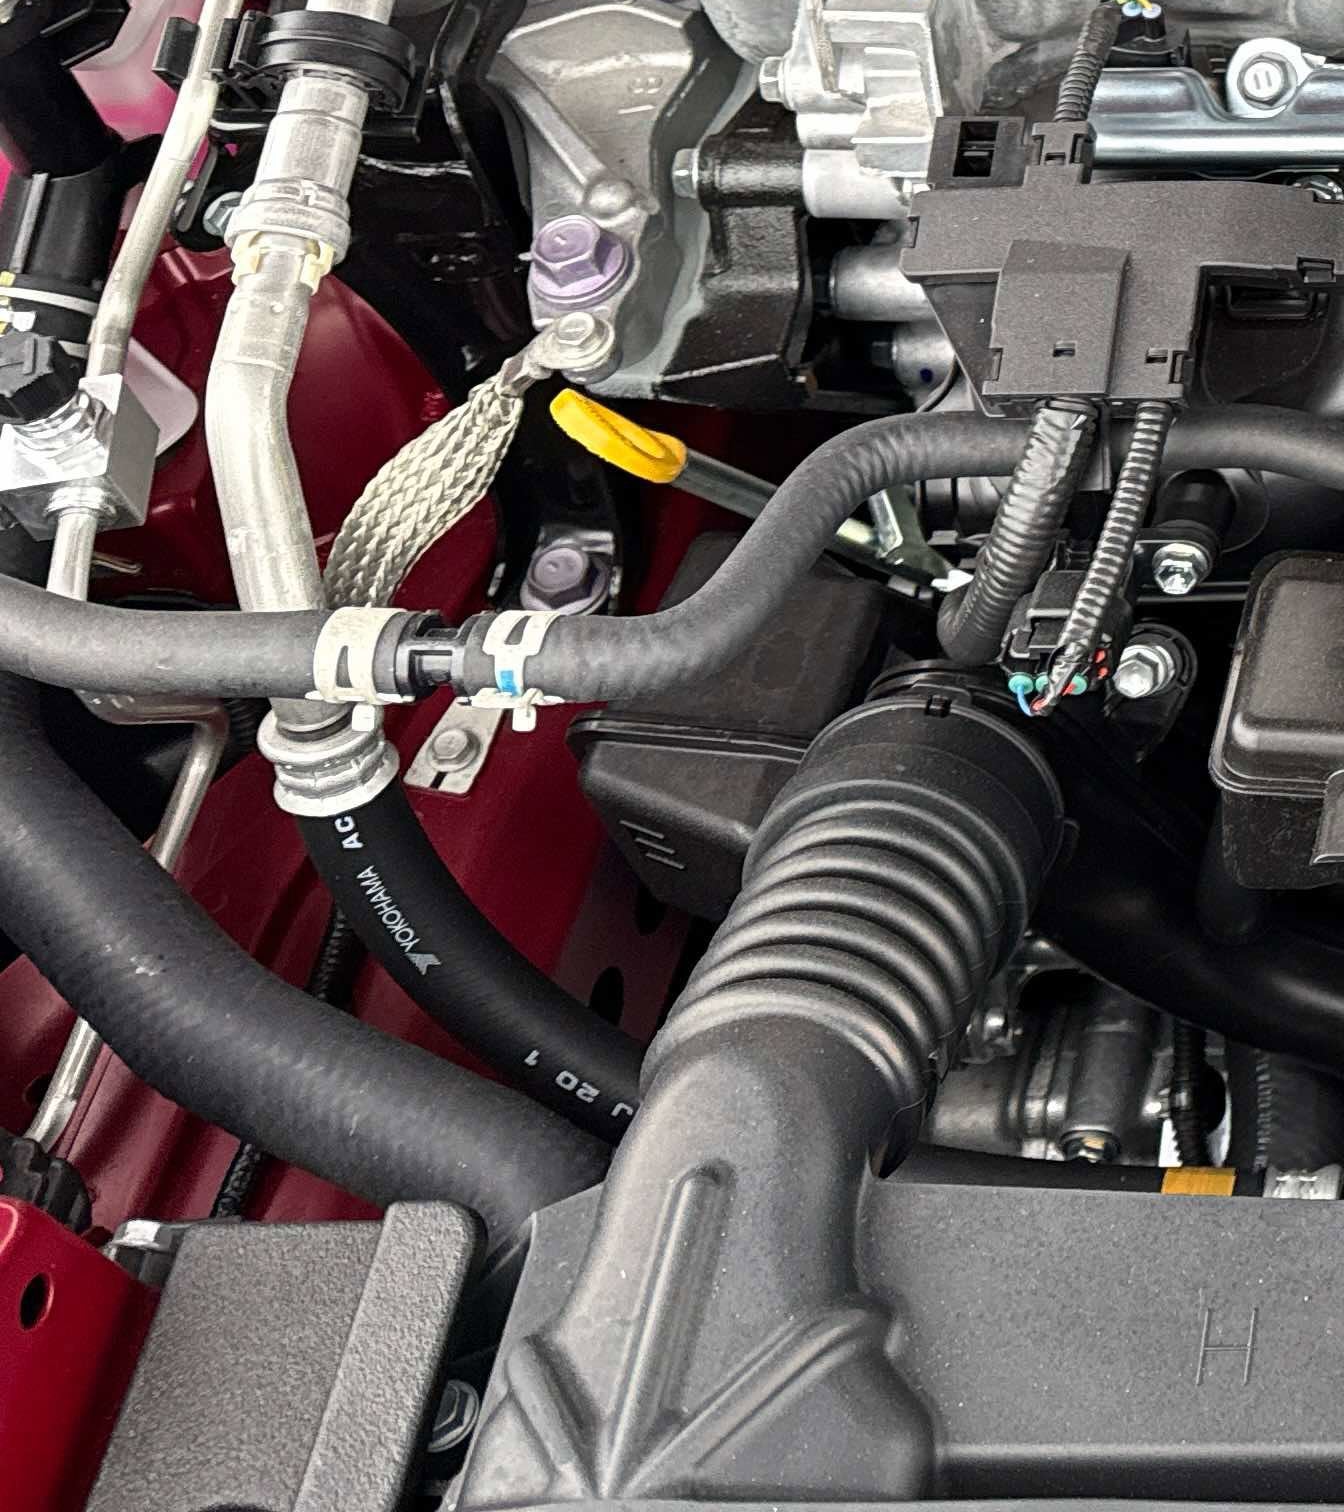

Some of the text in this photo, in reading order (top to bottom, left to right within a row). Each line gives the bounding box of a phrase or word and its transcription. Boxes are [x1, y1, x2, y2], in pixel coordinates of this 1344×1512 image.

[356, 864, 422, 953] YOKOHAMA
[523, 1049, 541, 1067] 1
[555, 1069, 601, 1104] 20
